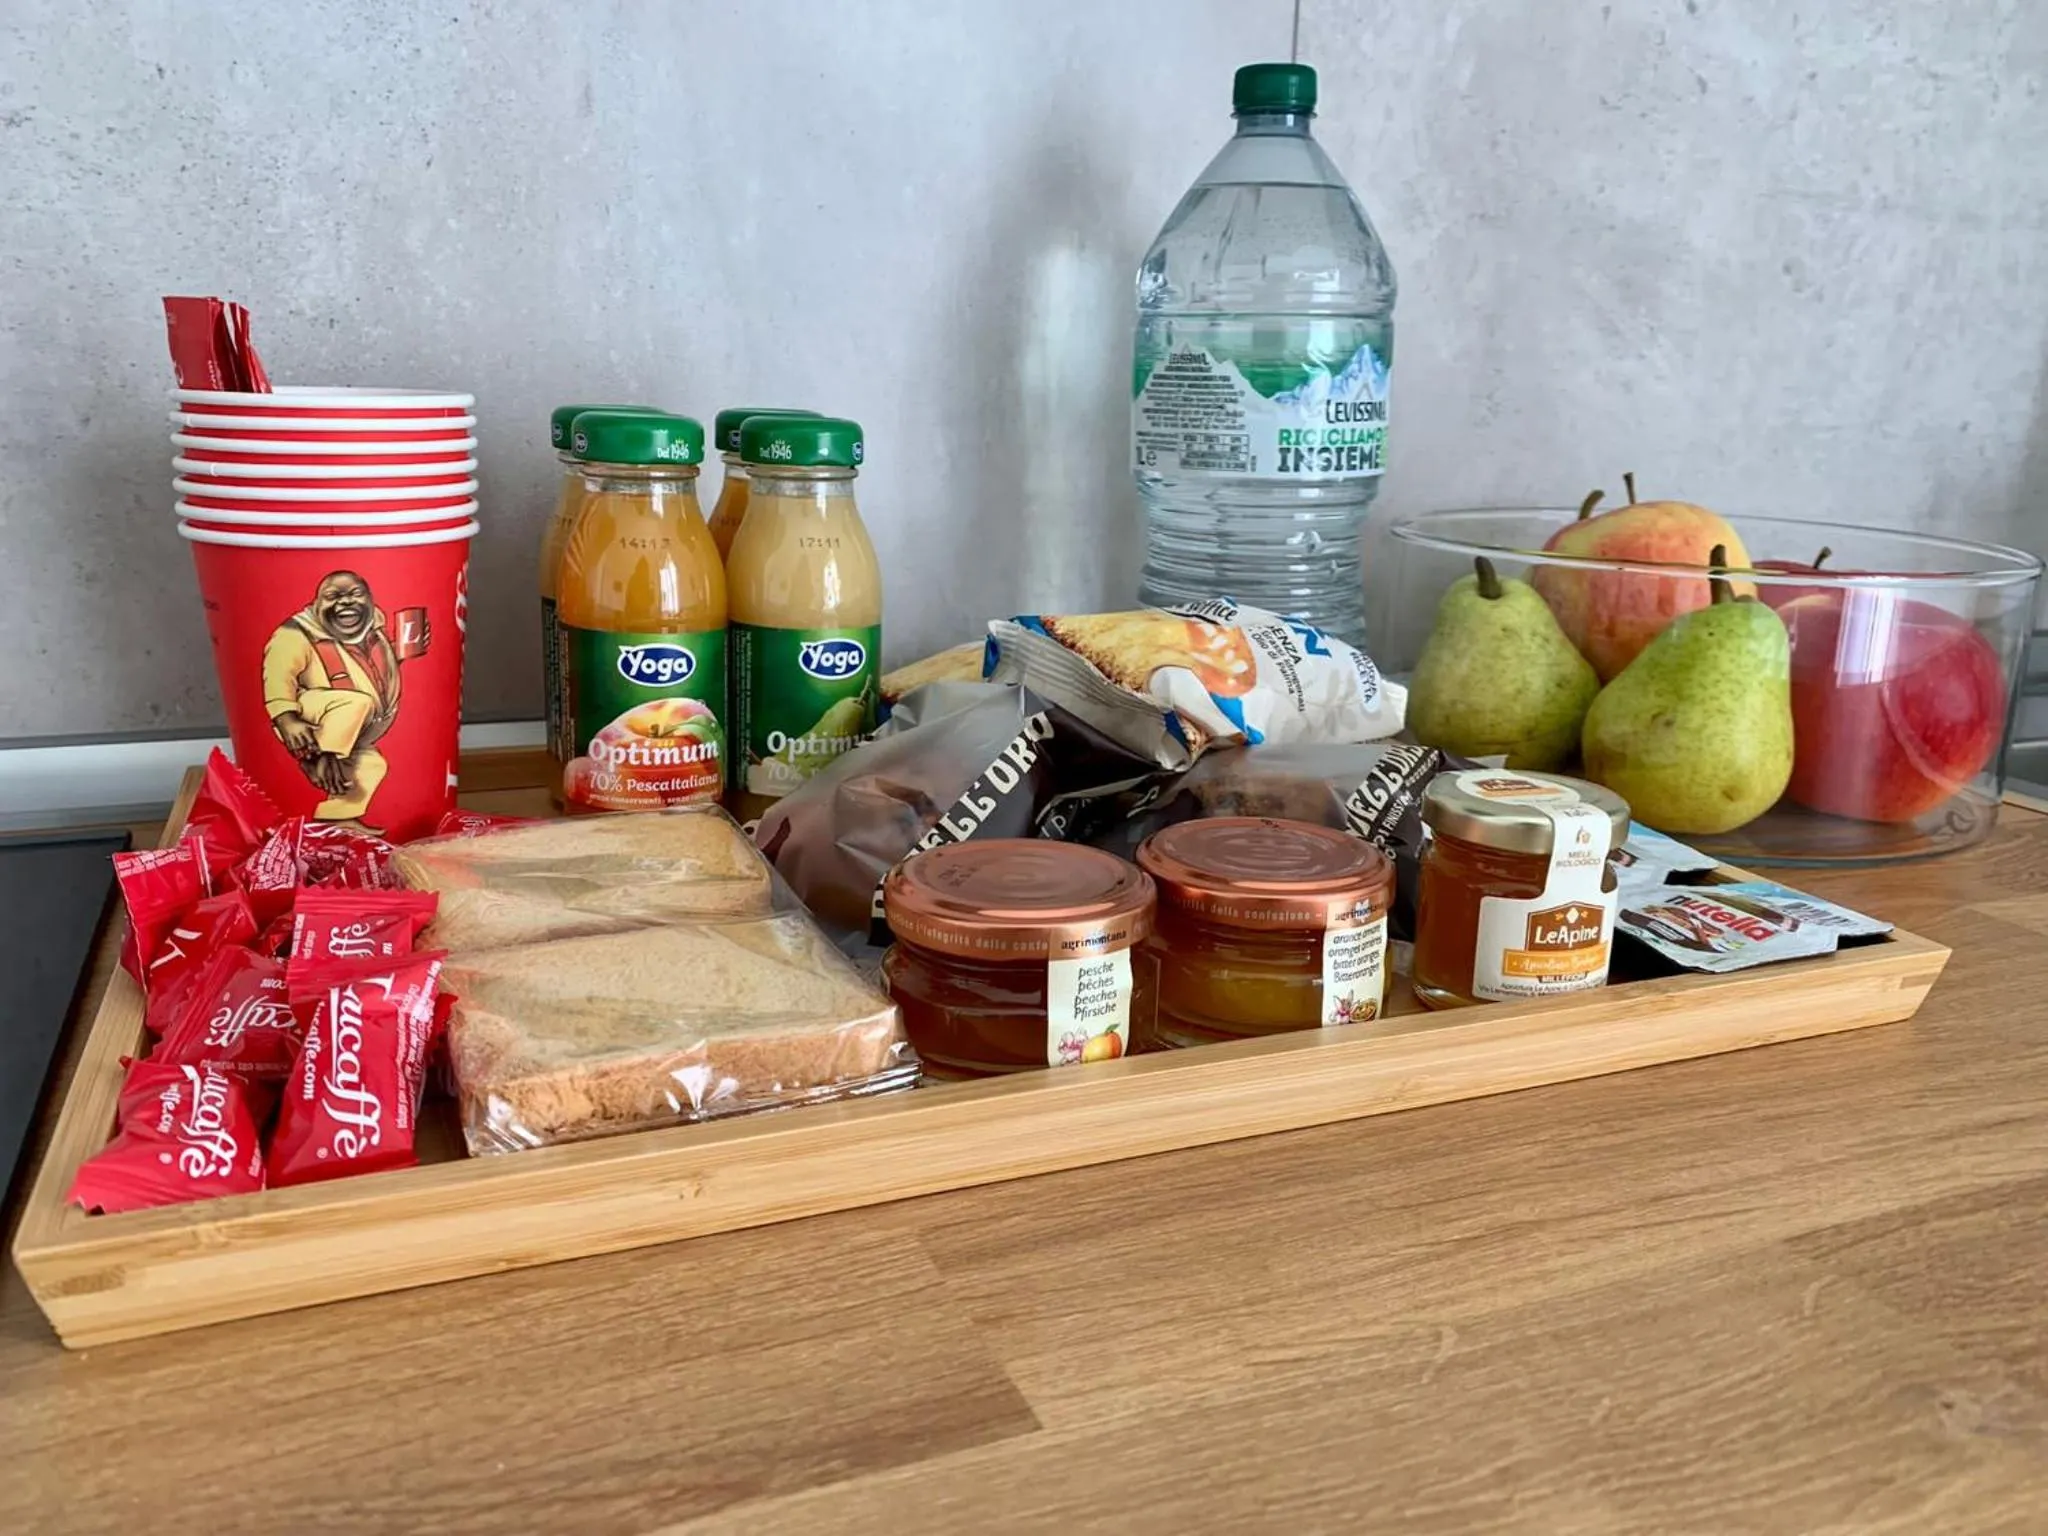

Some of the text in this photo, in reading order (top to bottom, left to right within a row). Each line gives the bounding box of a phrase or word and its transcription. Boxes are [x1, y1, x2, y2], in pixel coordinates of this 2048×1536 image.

[671, 443, 689, 459] 1946
[771, 443, 792, 459] 1946
[403, 621, 421, 644] L
[627, 650, 688, 681] Yoga
[807, 645, 859, 673] Yoga
[588, 737, 719, 773] Optimum
[767, 730, 863, 763] Optim
[589, 769, 623, 793] 70%
[1665, 894, 1776, 941] nutella
[1061, 930, 1127, 951] agrimontana
[1534, 924, 1599, 948] LeApine
[1078, 961, 1114, 981] pesche
[1074, 989, 1117, 1008] peaches
[1073, 1003, 1117, 1022] Pfirsiche
